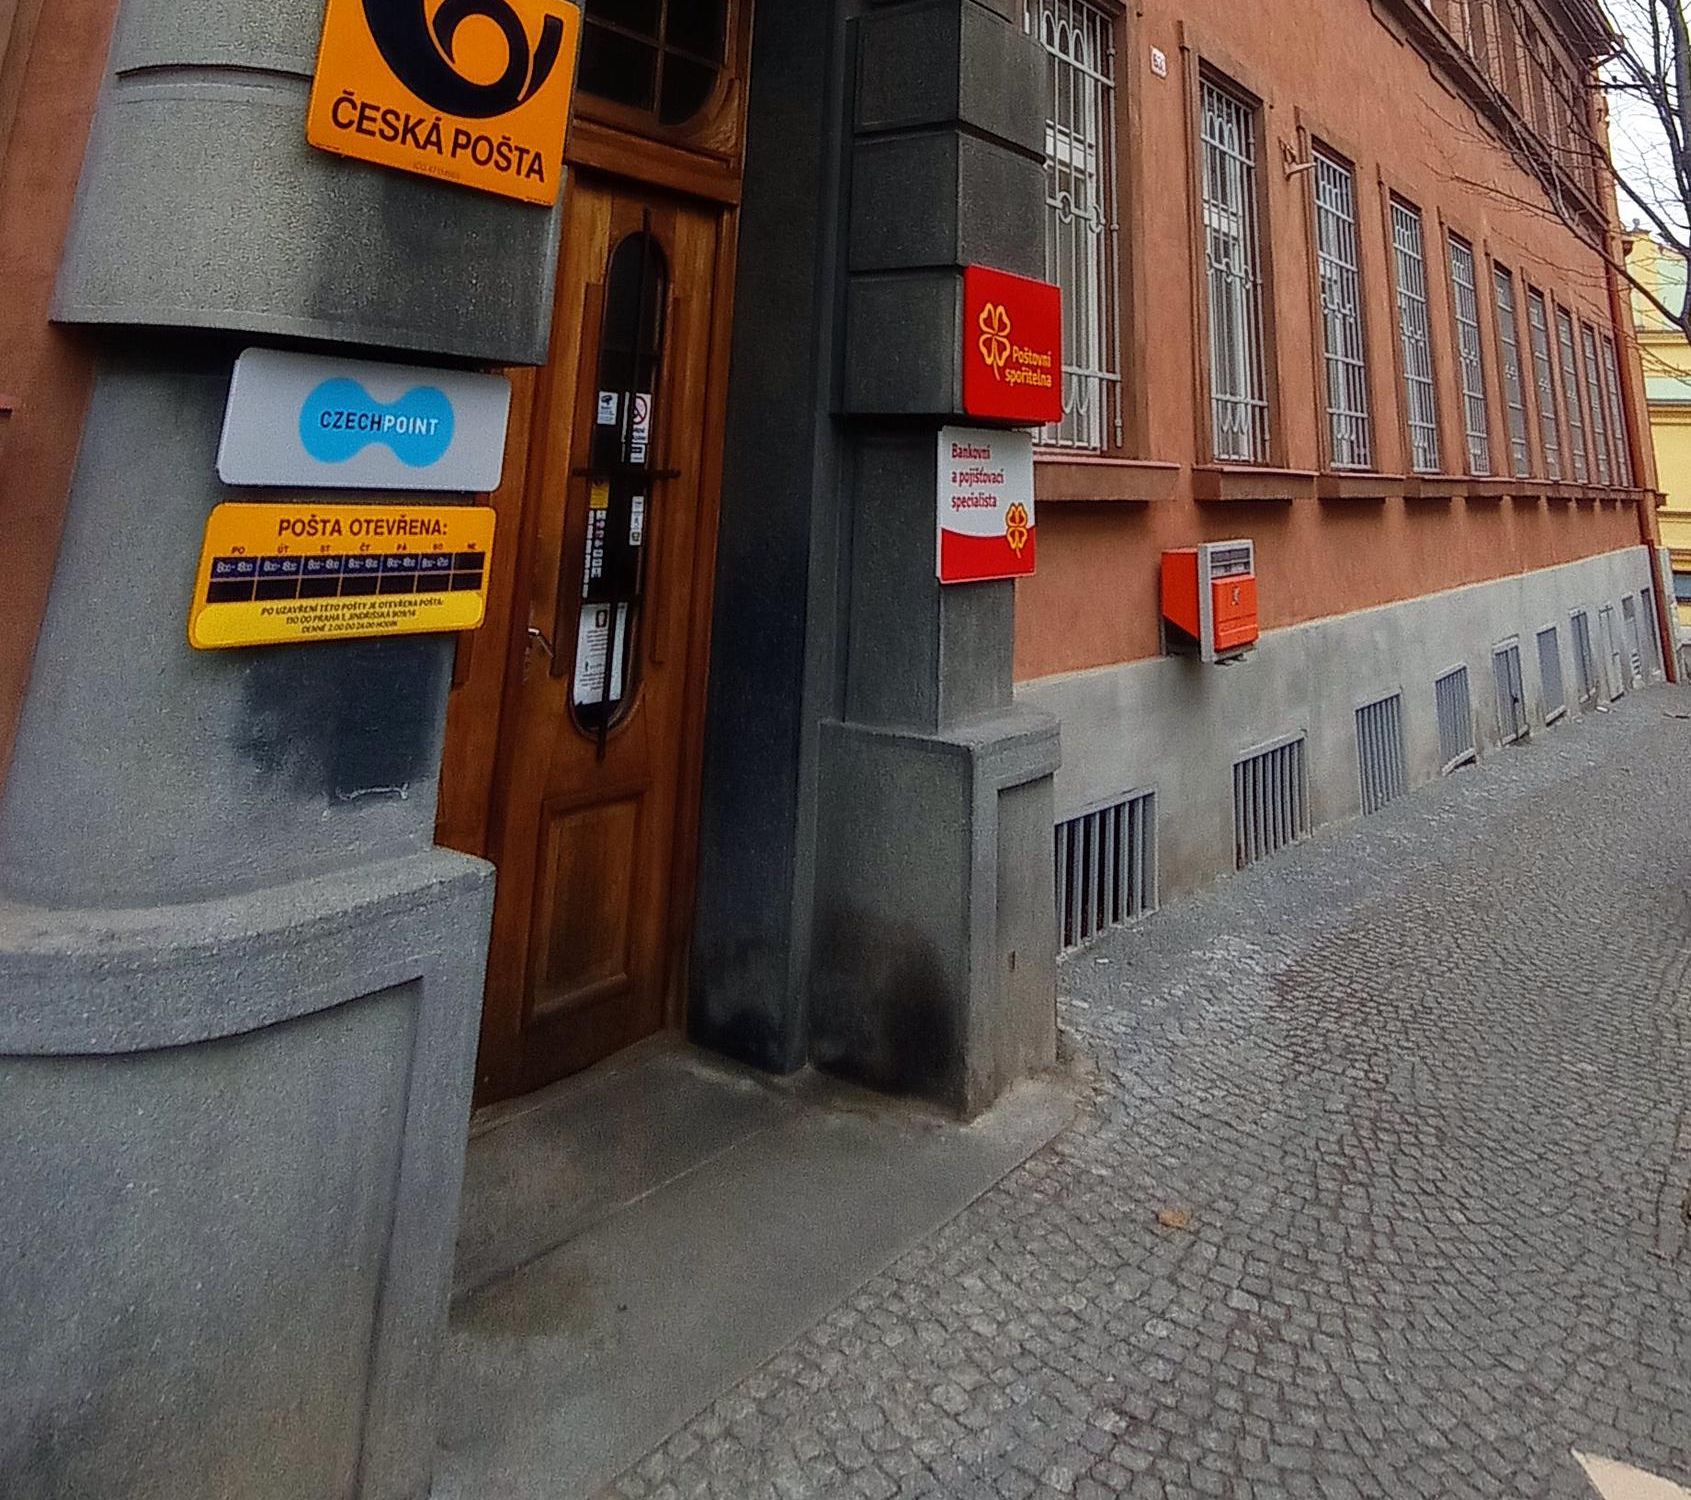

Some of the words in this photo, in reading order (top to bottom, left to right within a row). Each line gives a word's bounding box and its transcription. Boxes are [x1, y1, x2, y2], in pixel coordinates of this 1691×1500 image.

[331, 89, 443, 155] ČESKÁ
[451, 128, 545, 183] POŠTA
[1012, 345, 1052, 367] Poštovní
[1004, 366, 1053, 387] spořitelna
[952, 442, 991, 459] Bankovní
[951, 471, 957, 483] a
[951, 492, 997, 511] specialista
[278, 514, 343, 537] POŠTA
[349, 513, 448, 536] OTEVŘENA:
[231, 545, 246, 555] PO
